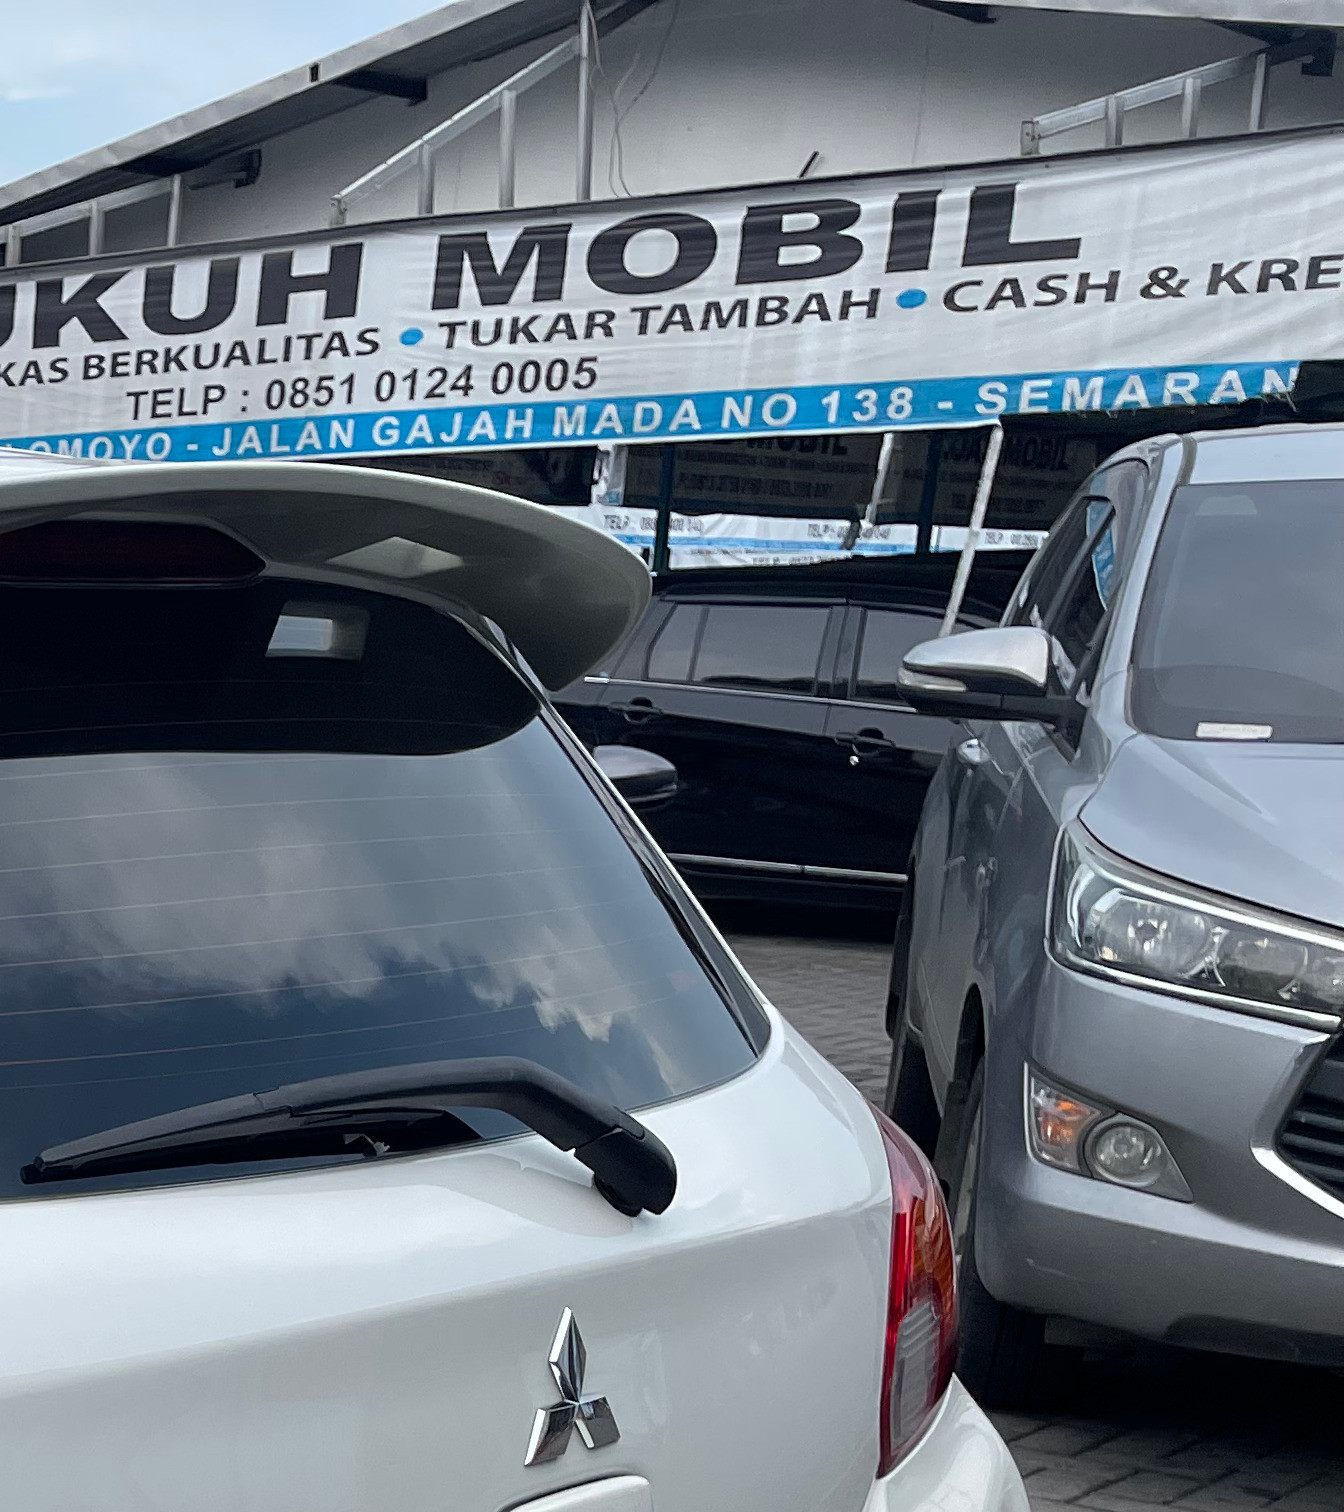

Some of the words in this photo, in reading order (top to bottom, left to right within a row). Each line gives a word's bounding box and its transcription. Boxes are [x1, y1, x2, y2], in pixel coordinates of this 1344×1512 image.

[431, 182, 1081, 310] MOBIL
[82, 326, 380, 381] BERKUALITAS
[438, 310, 616, 349] TUKAR
[631, 287, 881, 335] TAMBAH
[943, 270, 1121, 312] CASH
[1139, 265, 1190, 299] &
[1206, 254, 1344, 296] KRE
[127, 384, 227, 421] TELP
[265, 373, 355, 411] 0851
[374, 364, 474, 403] 0124
[491, 356, 598, 396] 0005
[212, 418, 355, 457] JALAN
[372, 408, 533, 447] GAJAH
[553, 399, 701, 437] MADA
[721, 392, 798, 429] NO
[822, 386, 913, 423] 138
